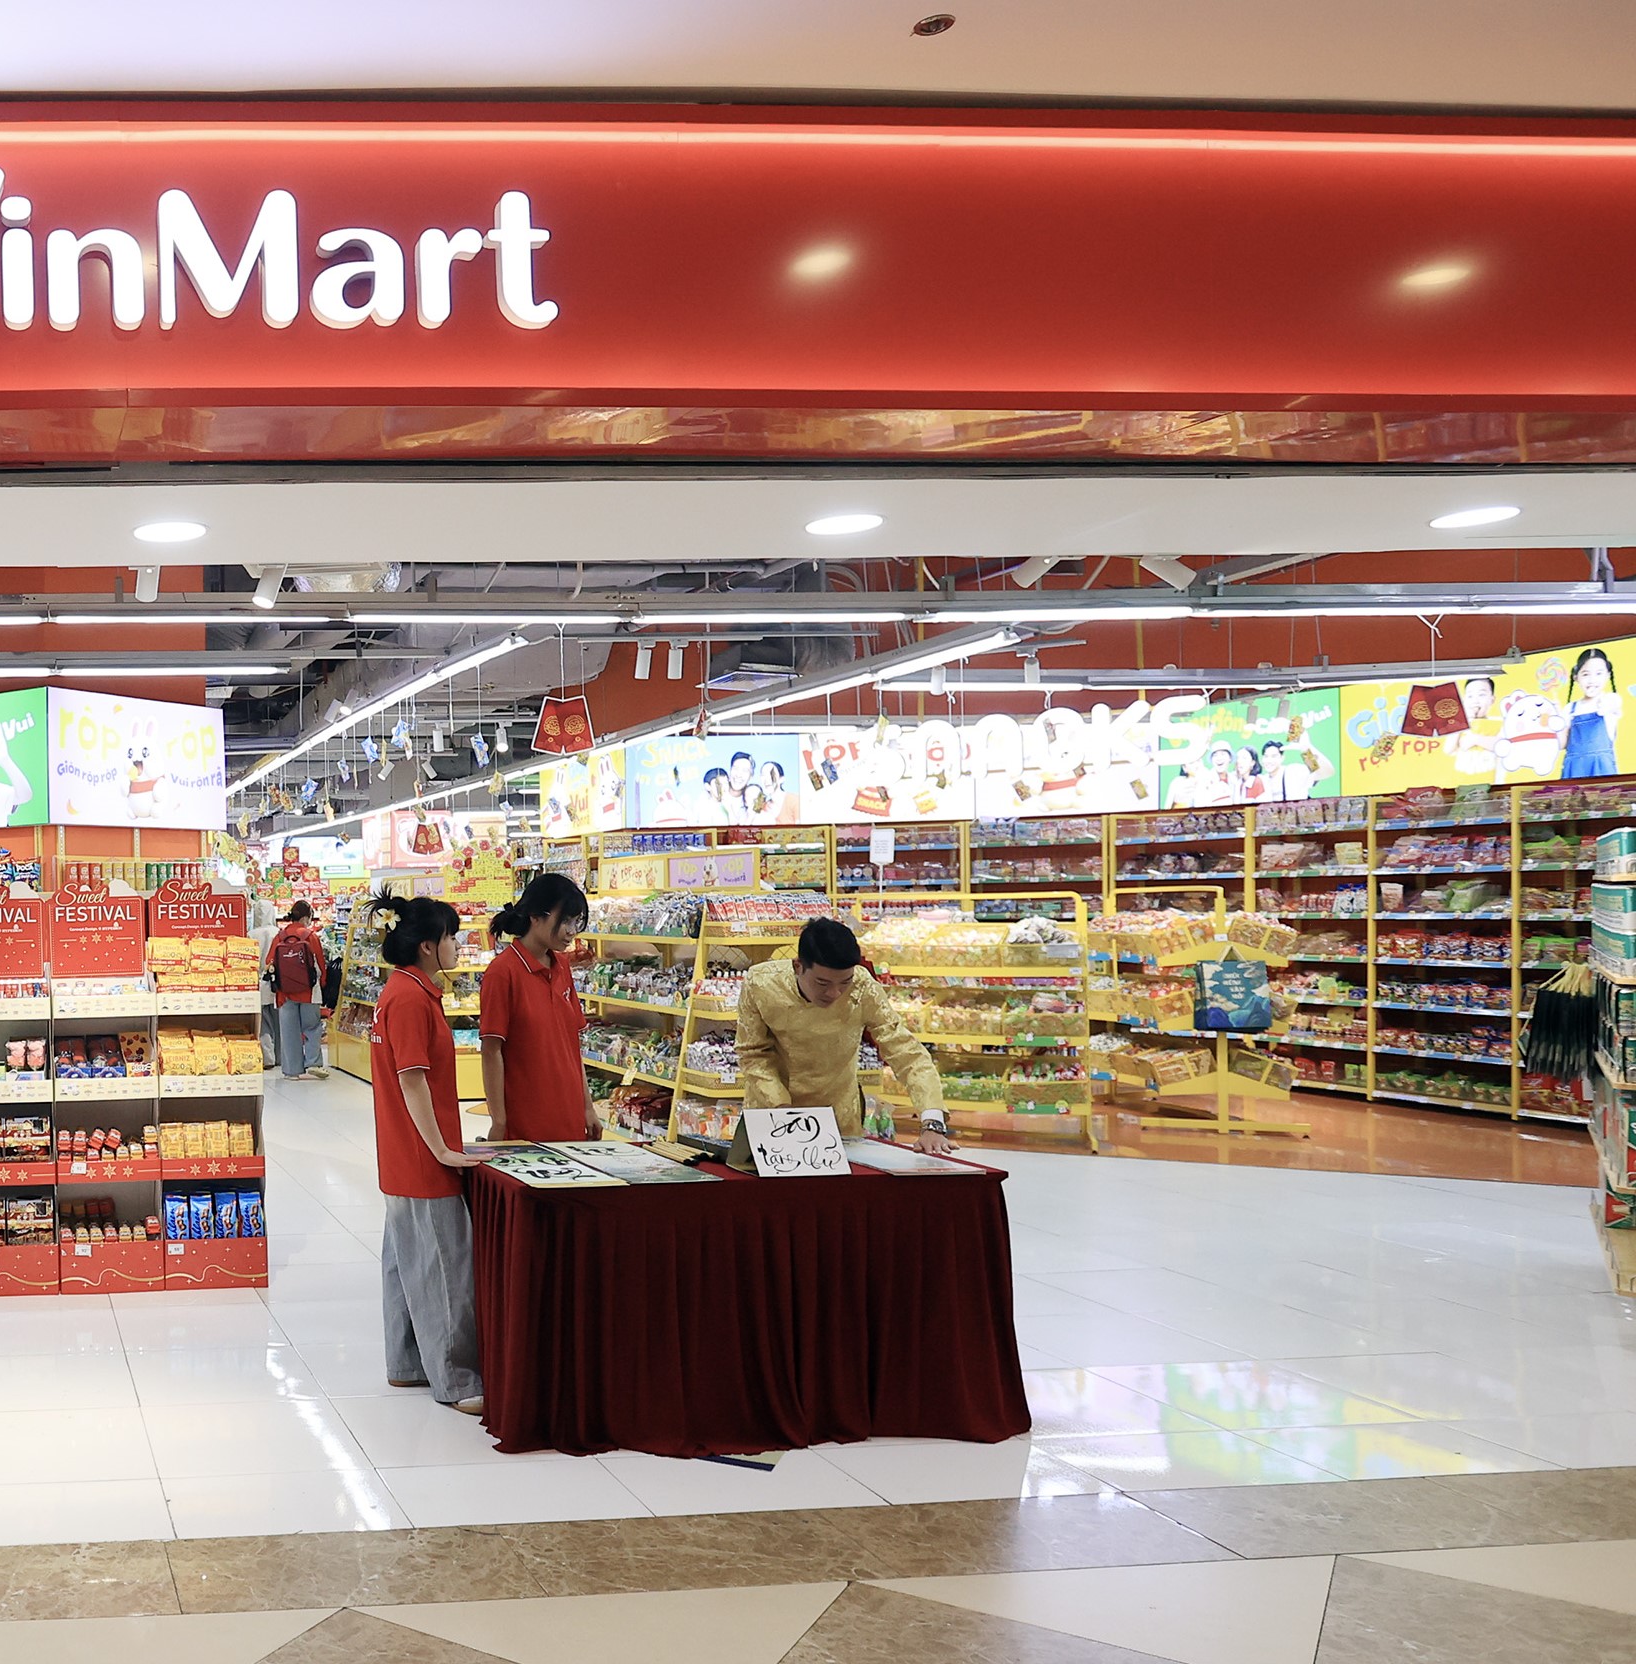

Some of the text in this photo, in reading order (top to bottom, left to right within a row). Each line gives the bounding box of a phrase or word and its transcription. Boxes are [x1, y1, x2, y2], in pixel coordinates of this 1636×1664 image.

[55, 883, 107, 906] Sweet
[158, 880, 209, 904] Sweet
[55, 904, 137, 922] FESTIVAL
[157, 903, 239, 920] FESTIVAL
